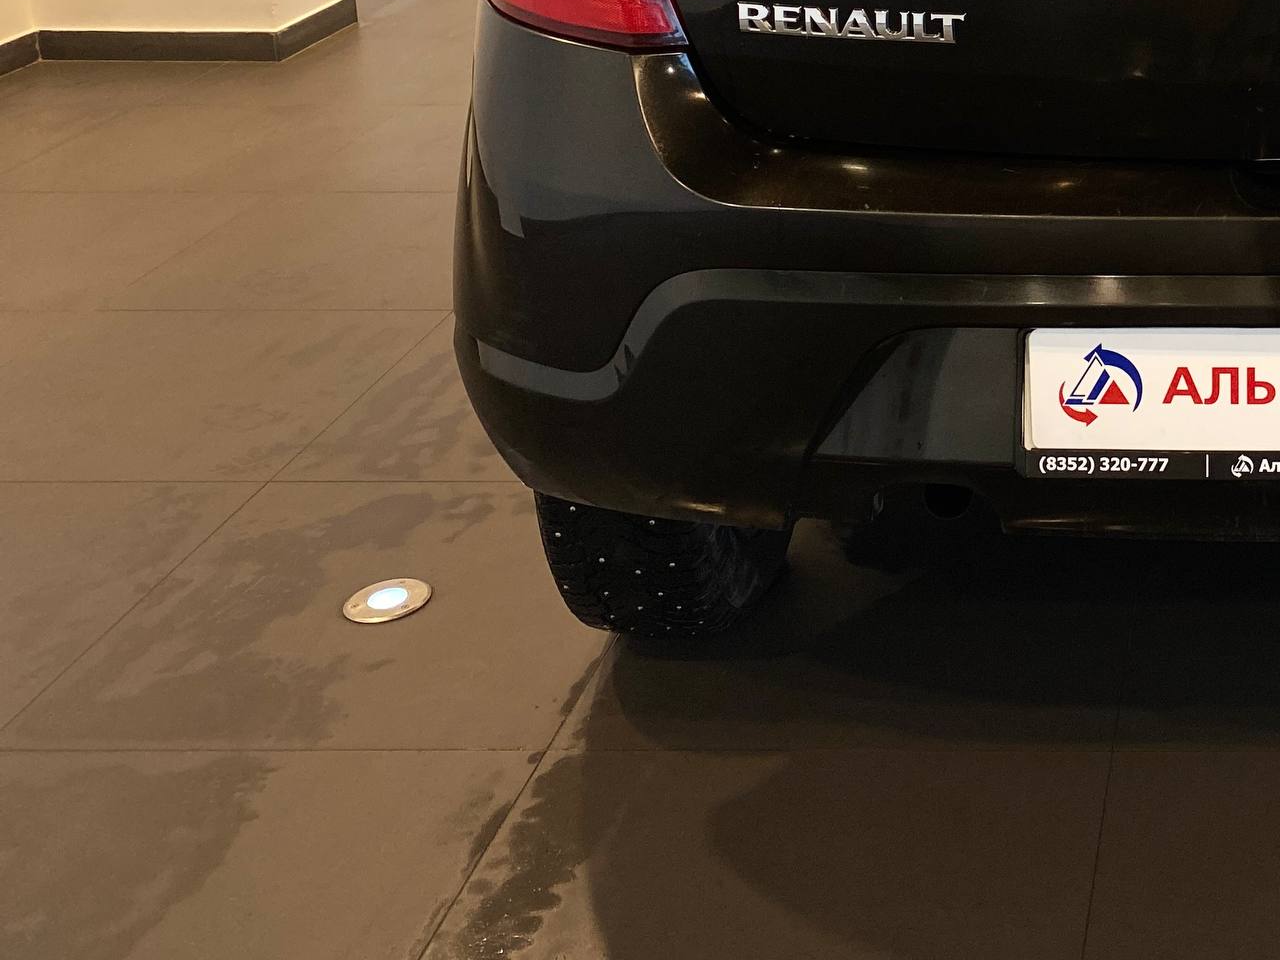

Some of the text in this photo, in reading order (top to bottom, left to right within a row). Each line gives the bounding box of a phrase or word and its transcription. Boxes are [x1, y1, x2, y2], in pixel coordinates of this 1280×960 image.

[737, 0, 967, 44] RENAULT
[1038, 455, 1169, 474] (8352) 320-777
